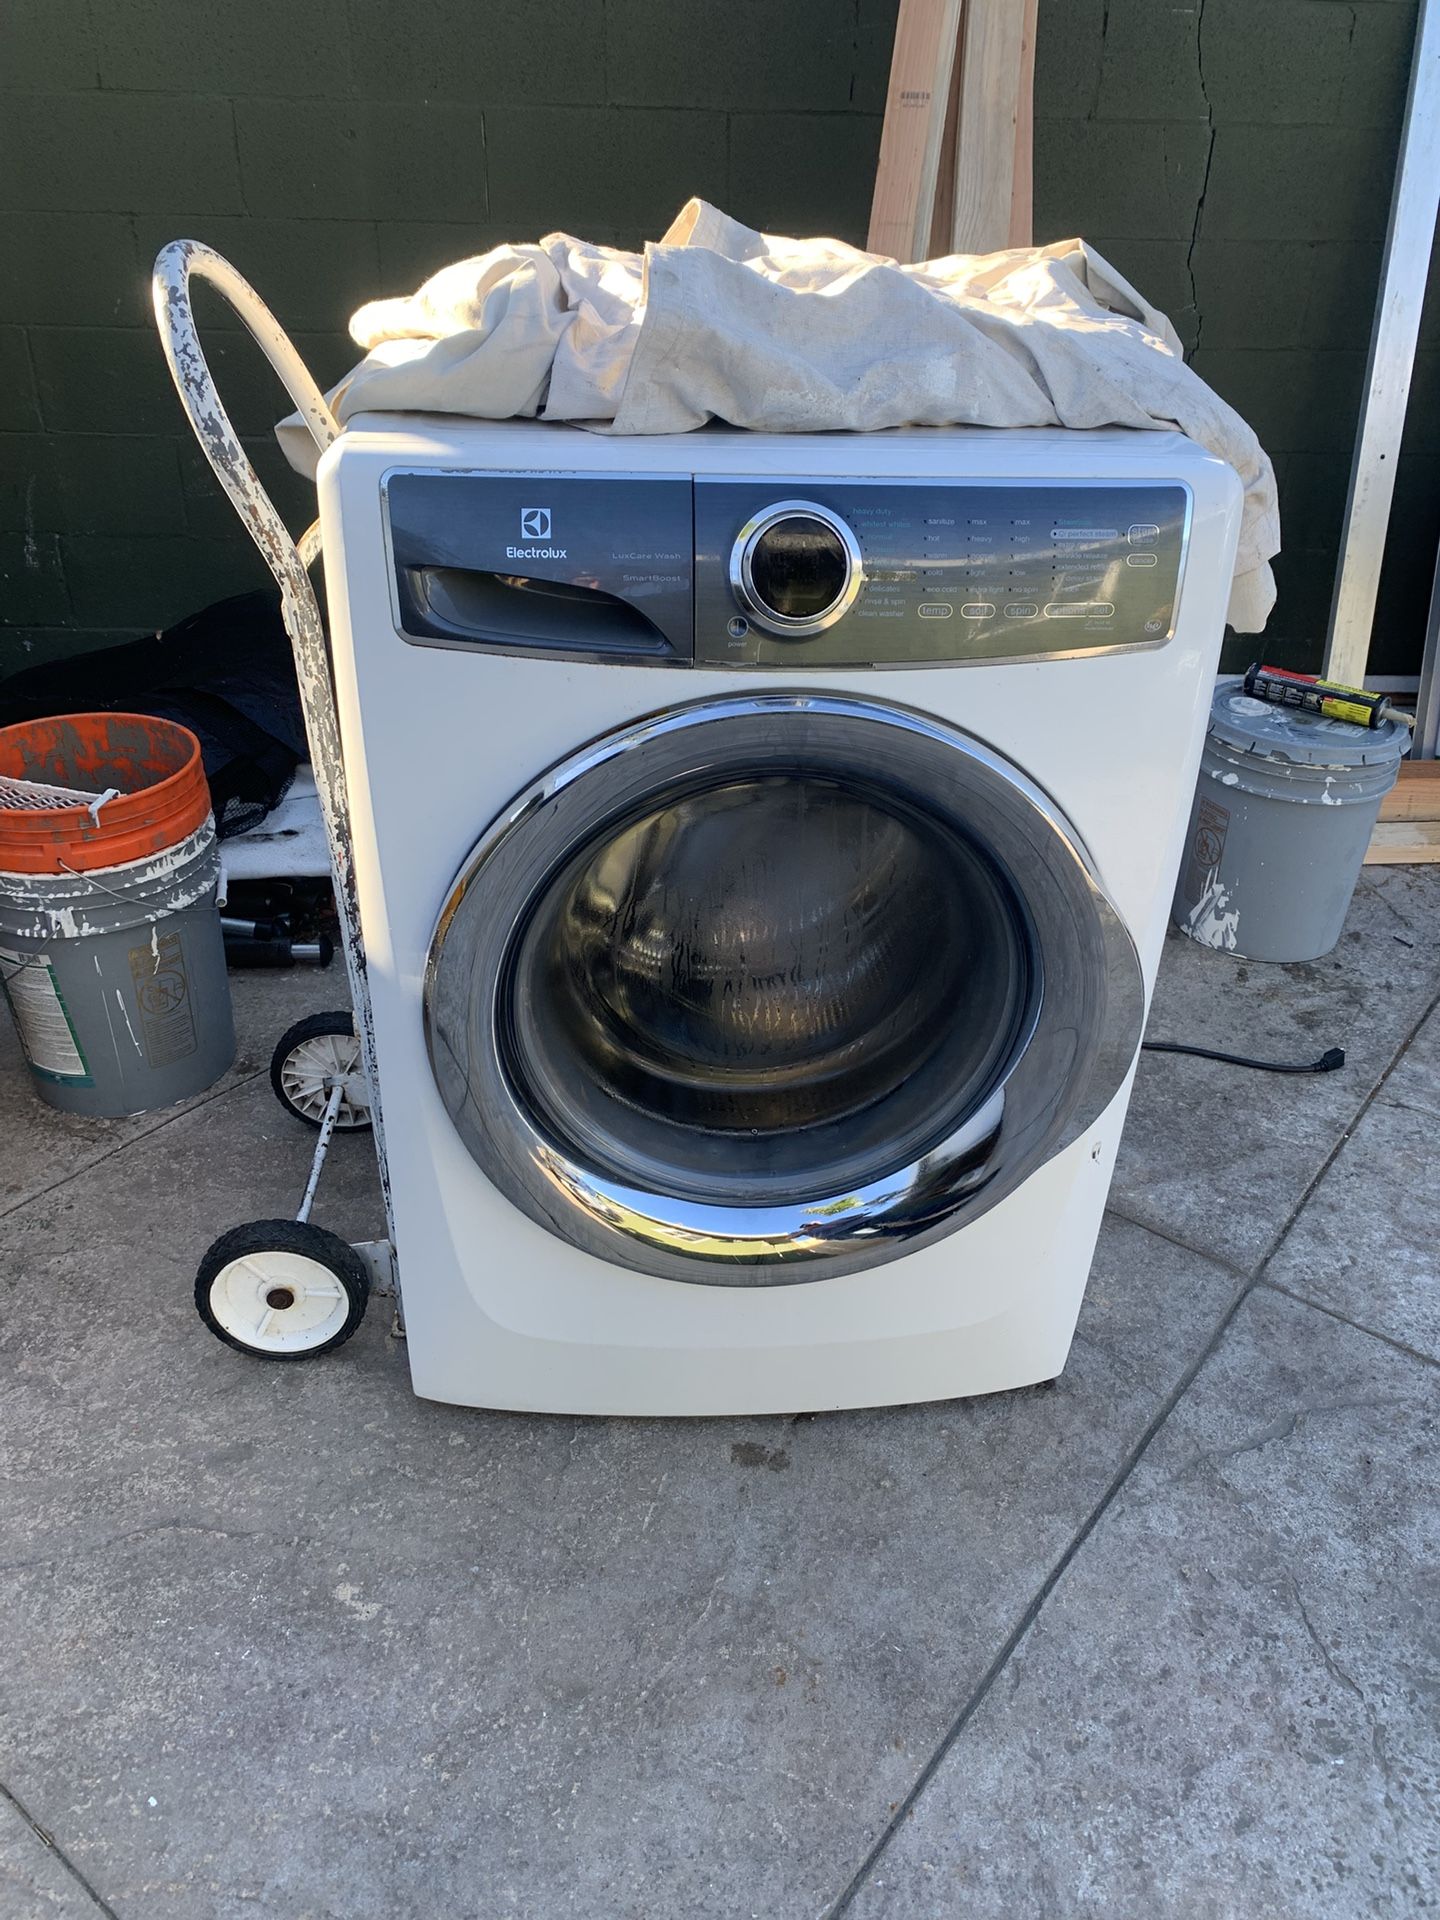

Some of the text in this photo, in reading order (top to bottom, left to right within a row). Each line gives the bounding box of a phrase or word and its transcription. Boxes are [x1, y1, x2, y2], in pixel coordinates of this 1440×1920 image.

[928, 518, 955, 526] sanitize
[972, 535, 992, 544] heavy
[1015, 535, 1030, 544] high
[506, 546, 567, 559] Electrolux
[612, 552, 681, 560] LuxCare Wash
[928, 569, 943, 577] cold
[1014, 569, 1026, 577] low
[623, 574, 681, 583] SmartBoost
[922, 605, 948, 616] temp
[1010, 605, 1031, 616] spin
[1094, 605, 1110, 615] set
[727, 641, 747, 649] power
